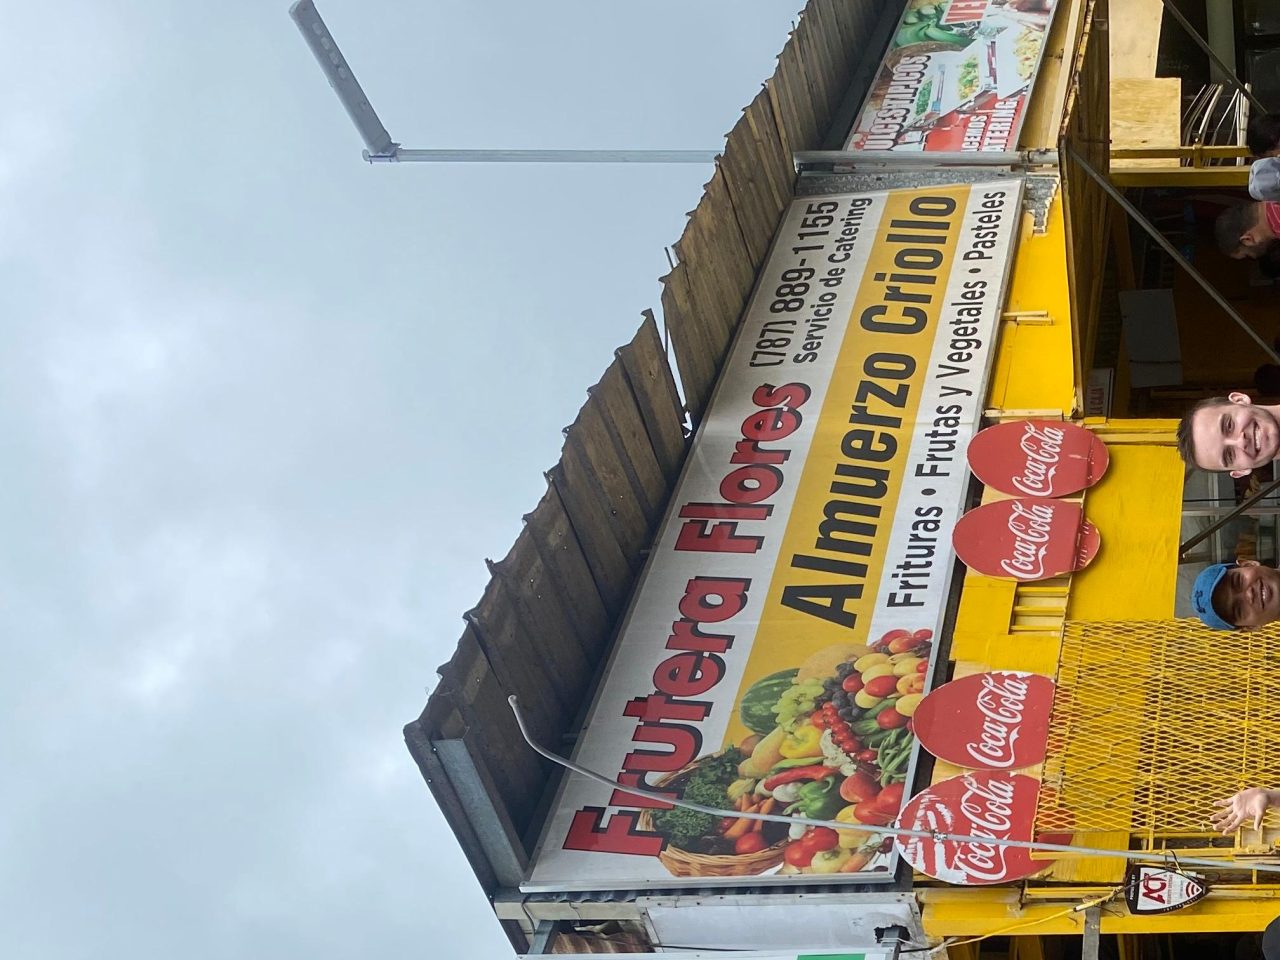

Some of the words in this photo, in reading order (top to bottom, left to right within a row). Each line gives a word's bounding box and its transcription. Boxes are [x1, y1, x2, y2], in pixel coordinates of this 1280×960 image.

[863, 108, 911, 150] ULCES
[981, 100, 1019, 152] ATERING
[770, 201, 839, 314] 889-1155
[829, 197, 873, 263] Catering
[962, 191, 1006, 261] Pasteles
[820, 267, 846, 287] de
[749, 320, 797, 367] (787)
[793, 292, 838, 363] Servicio
[935, 281, 987, 379] Vegetales
[780, 352, 917, 629] Almuerzo
[859, 195, 957, 335] Criollo
[939, 385, 973, 398] y
[914, 404, 962, 477] Frutas
[1012, 421, 1065, 496] Coca-Cola
[886, 506, 943, 608] Frituras
[1000, 500, 1054, 578] Coca-Cola
[562, 575, 751, 856] Frutera
[674, 383, 811, 554] Flores
[966, 674, 1029, 767] Coca-Cola
